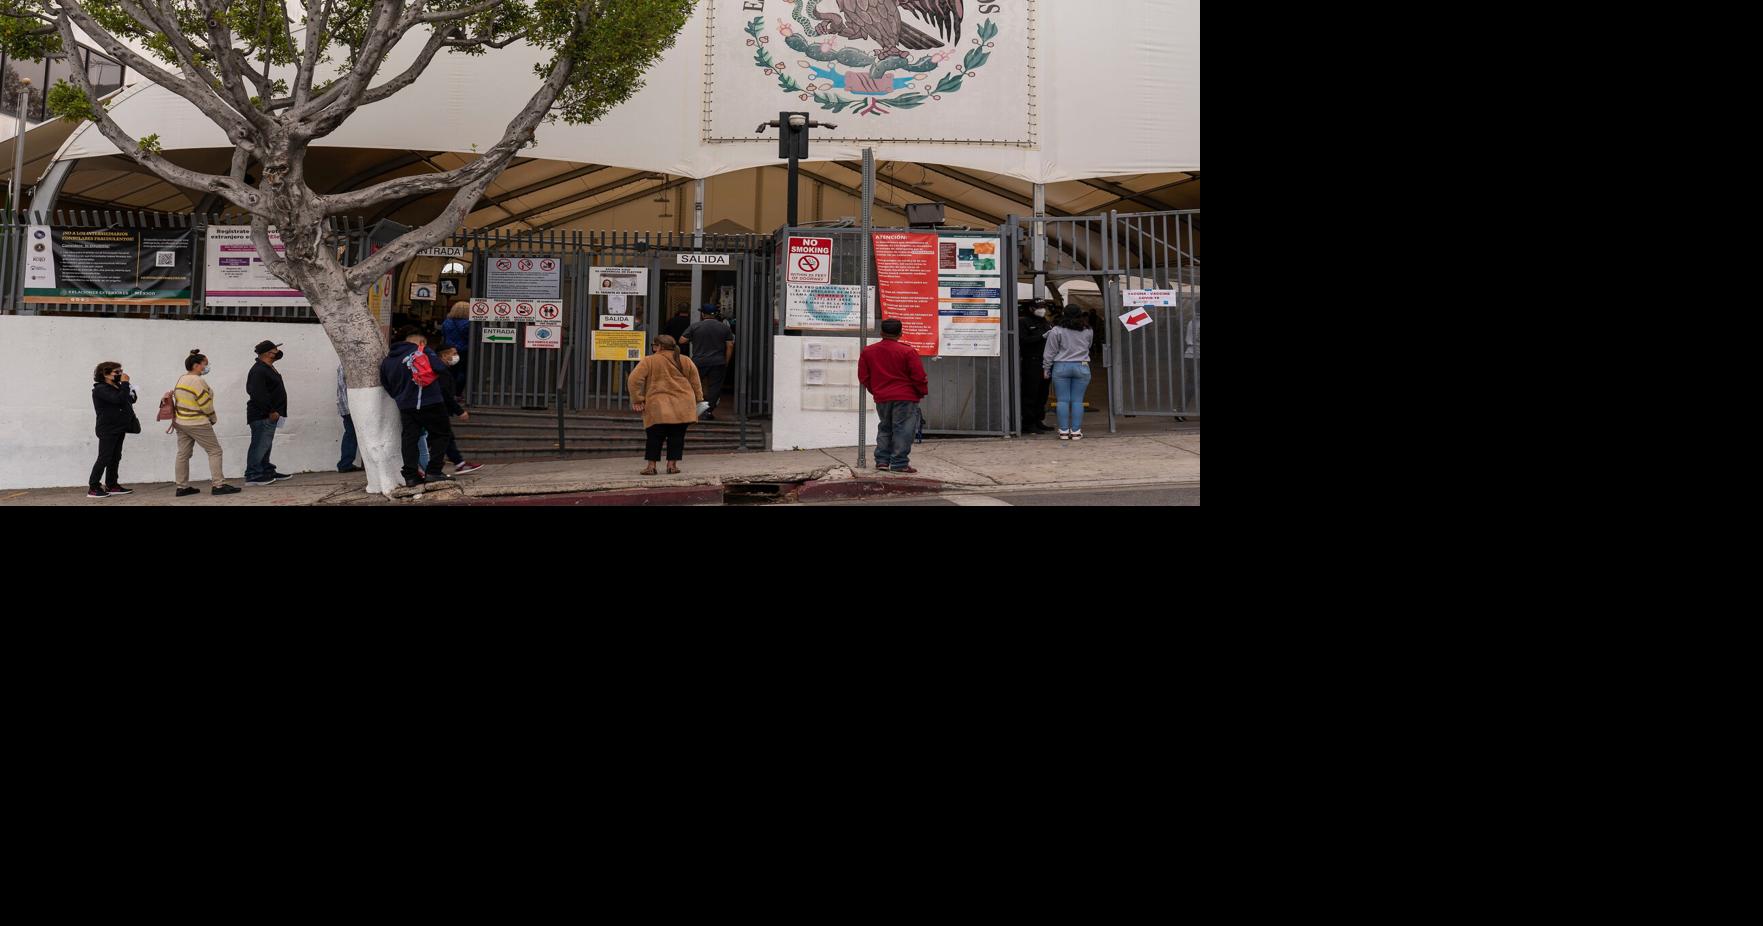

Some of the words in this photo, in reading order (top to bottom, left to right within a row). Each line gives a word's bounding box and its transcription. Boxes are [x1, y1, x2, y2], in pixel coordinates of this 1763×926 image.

[802, 238, 819, 246] NO
[417, 247, 461, 255] NTRADA
[791, 246, 829, 254] SMOKING
[681, 255, 725, 263] SALIDA
